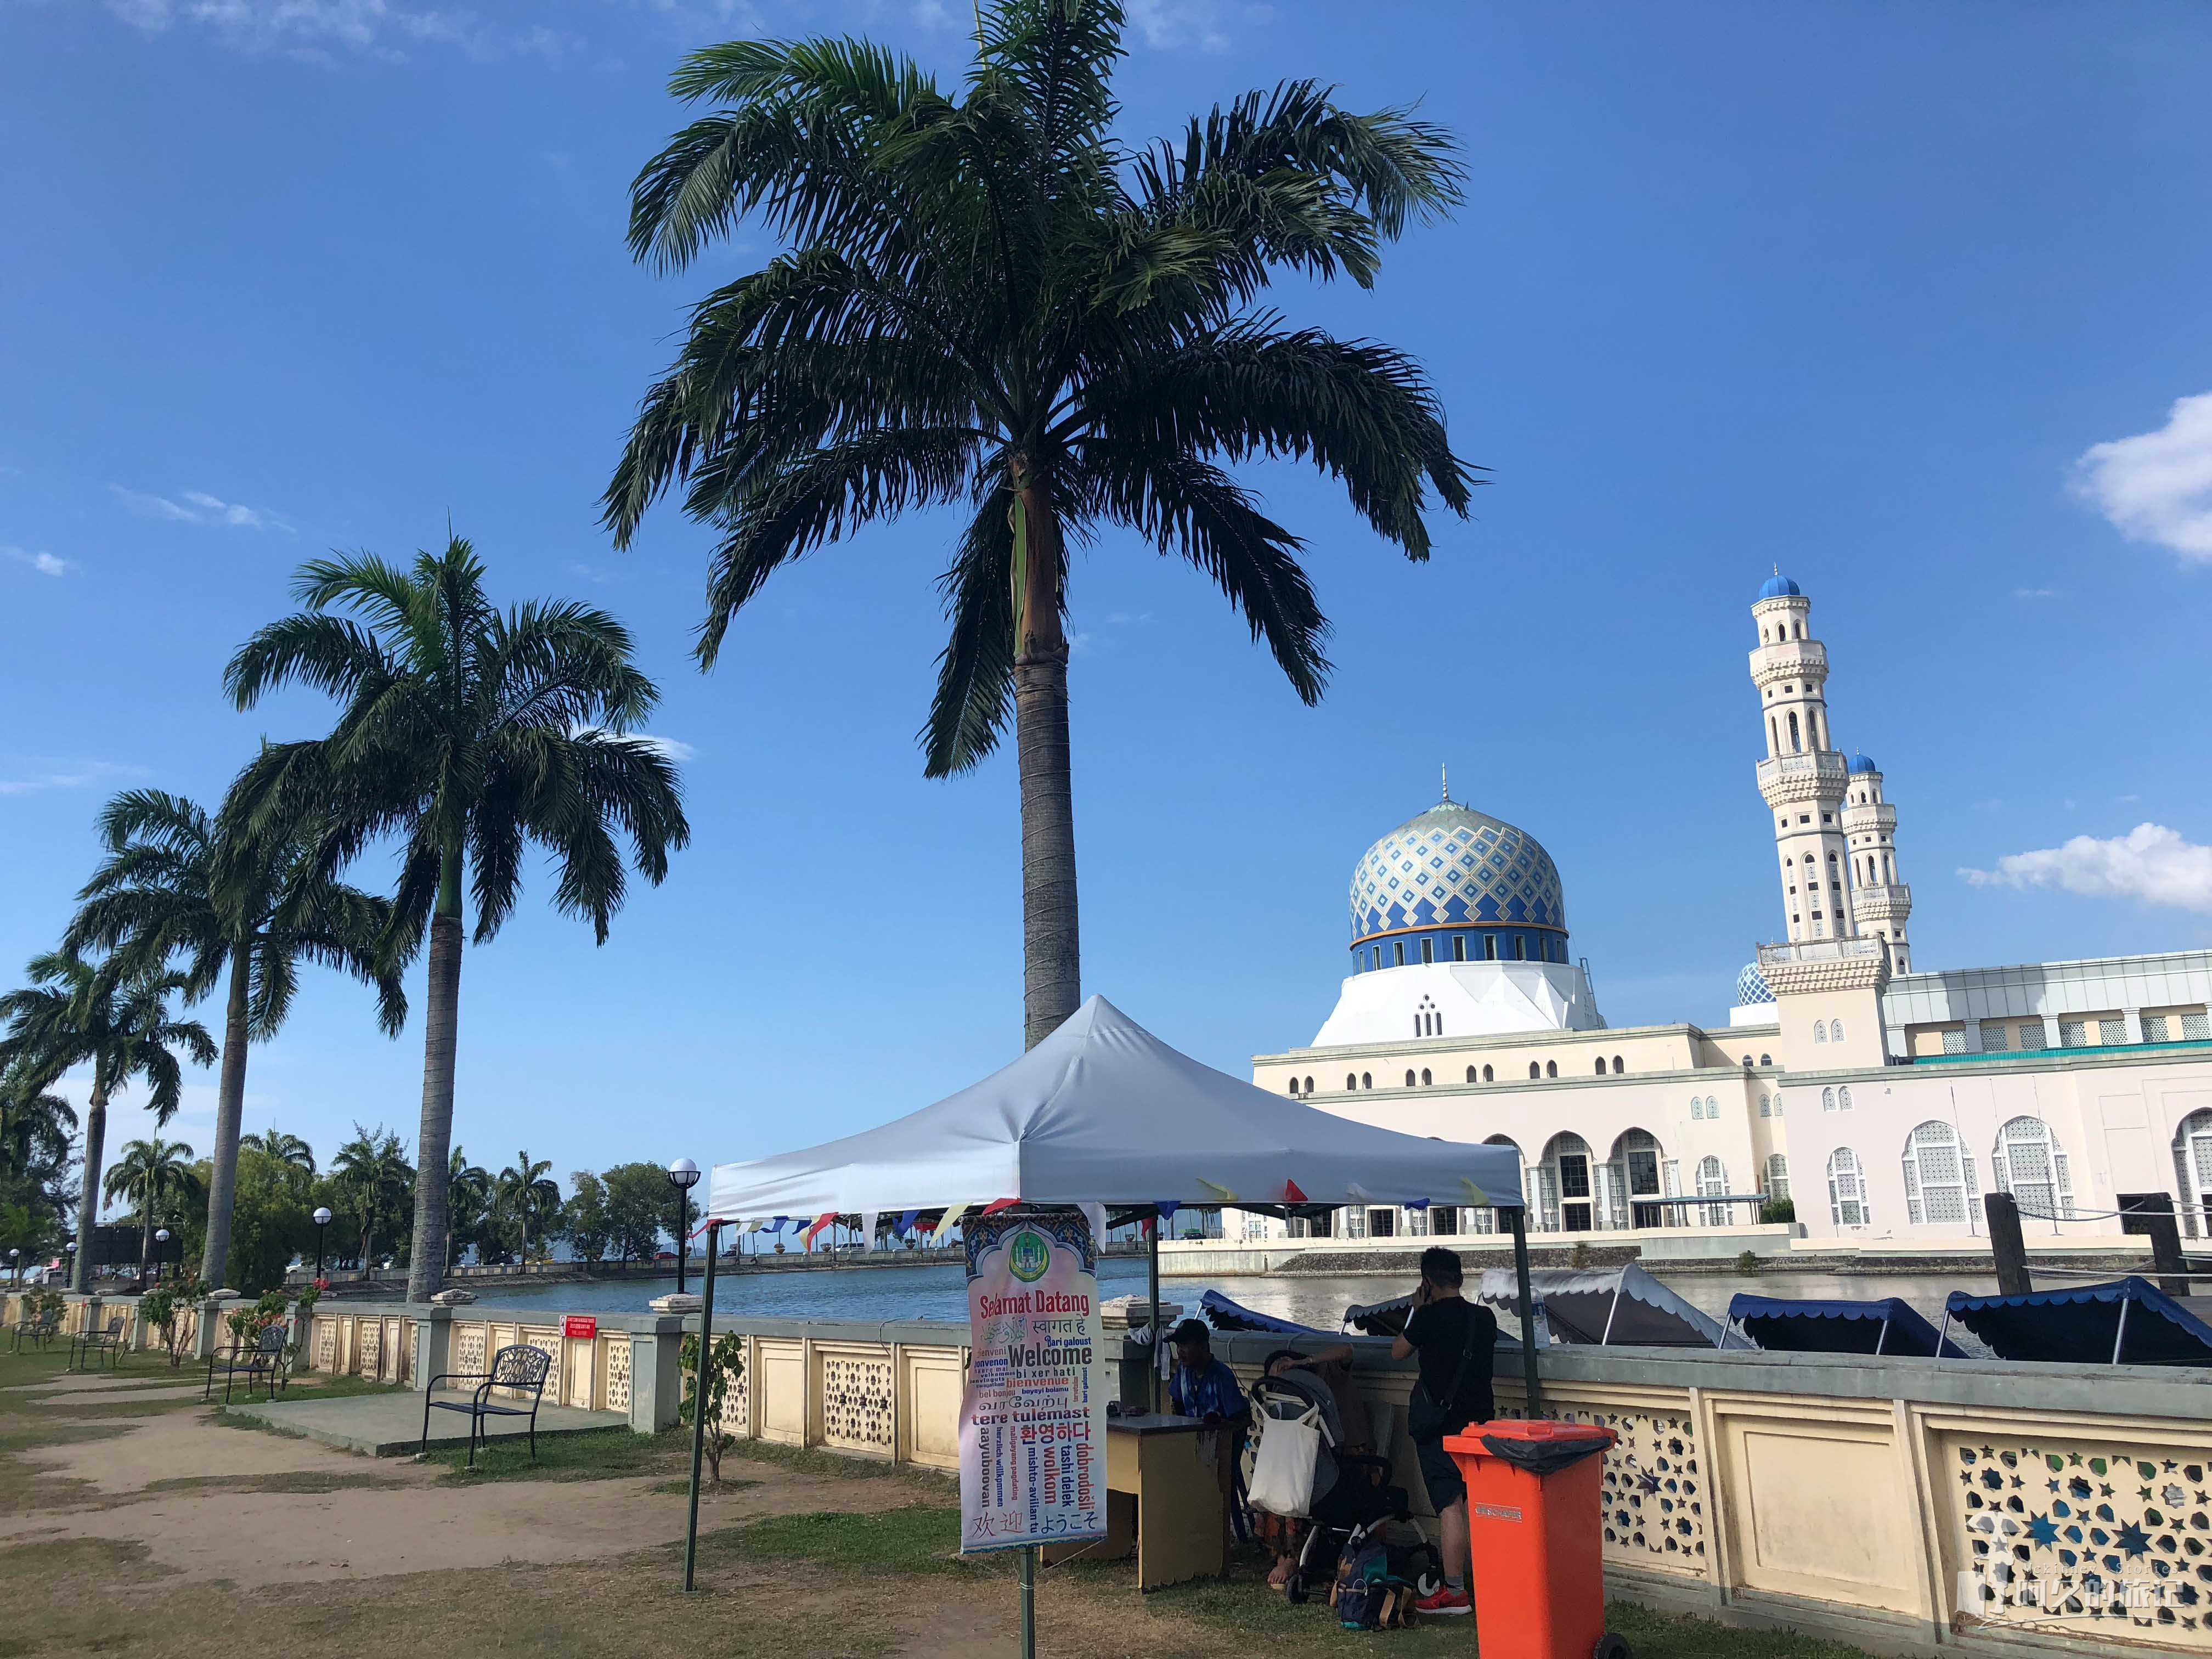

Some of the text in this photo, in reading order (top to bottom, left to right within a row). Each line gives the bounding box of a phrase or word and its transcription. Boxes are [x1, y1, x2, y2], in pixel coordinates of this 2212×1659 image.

[980, 1290, 1090, 1319] Selamat Datang
[1031, 1319, 1073, 1334] स्वागत
[1045, 1335, 1092, 1347] Bari galoust
[1008, 1342, 1092, 1368] Welcome
[1006, 1377, 1069, 1388] bienvenue
[1016, 1367, 1075, 1379] bi xer hati
[979, 1389, 1015, 1398] bel bonjou
[972, 1407, 1090, 1425] tere tulemast
[979, 1427, 993, 1508] aayuboovan
[1043, 1446, 1060, 1504] wolkom
[1061, 1444, 1075, 1508] tashi delek
[1076, 1443, 1095, 1510] dobrodošli
[1011, 1466, 1019, 1501] pagdating
[972, 1510, 1026, 1539] 欢迎
[1030, 1522, 1039, 1533] tu
[1041, 1511, 1098, 1534] ようこそ
